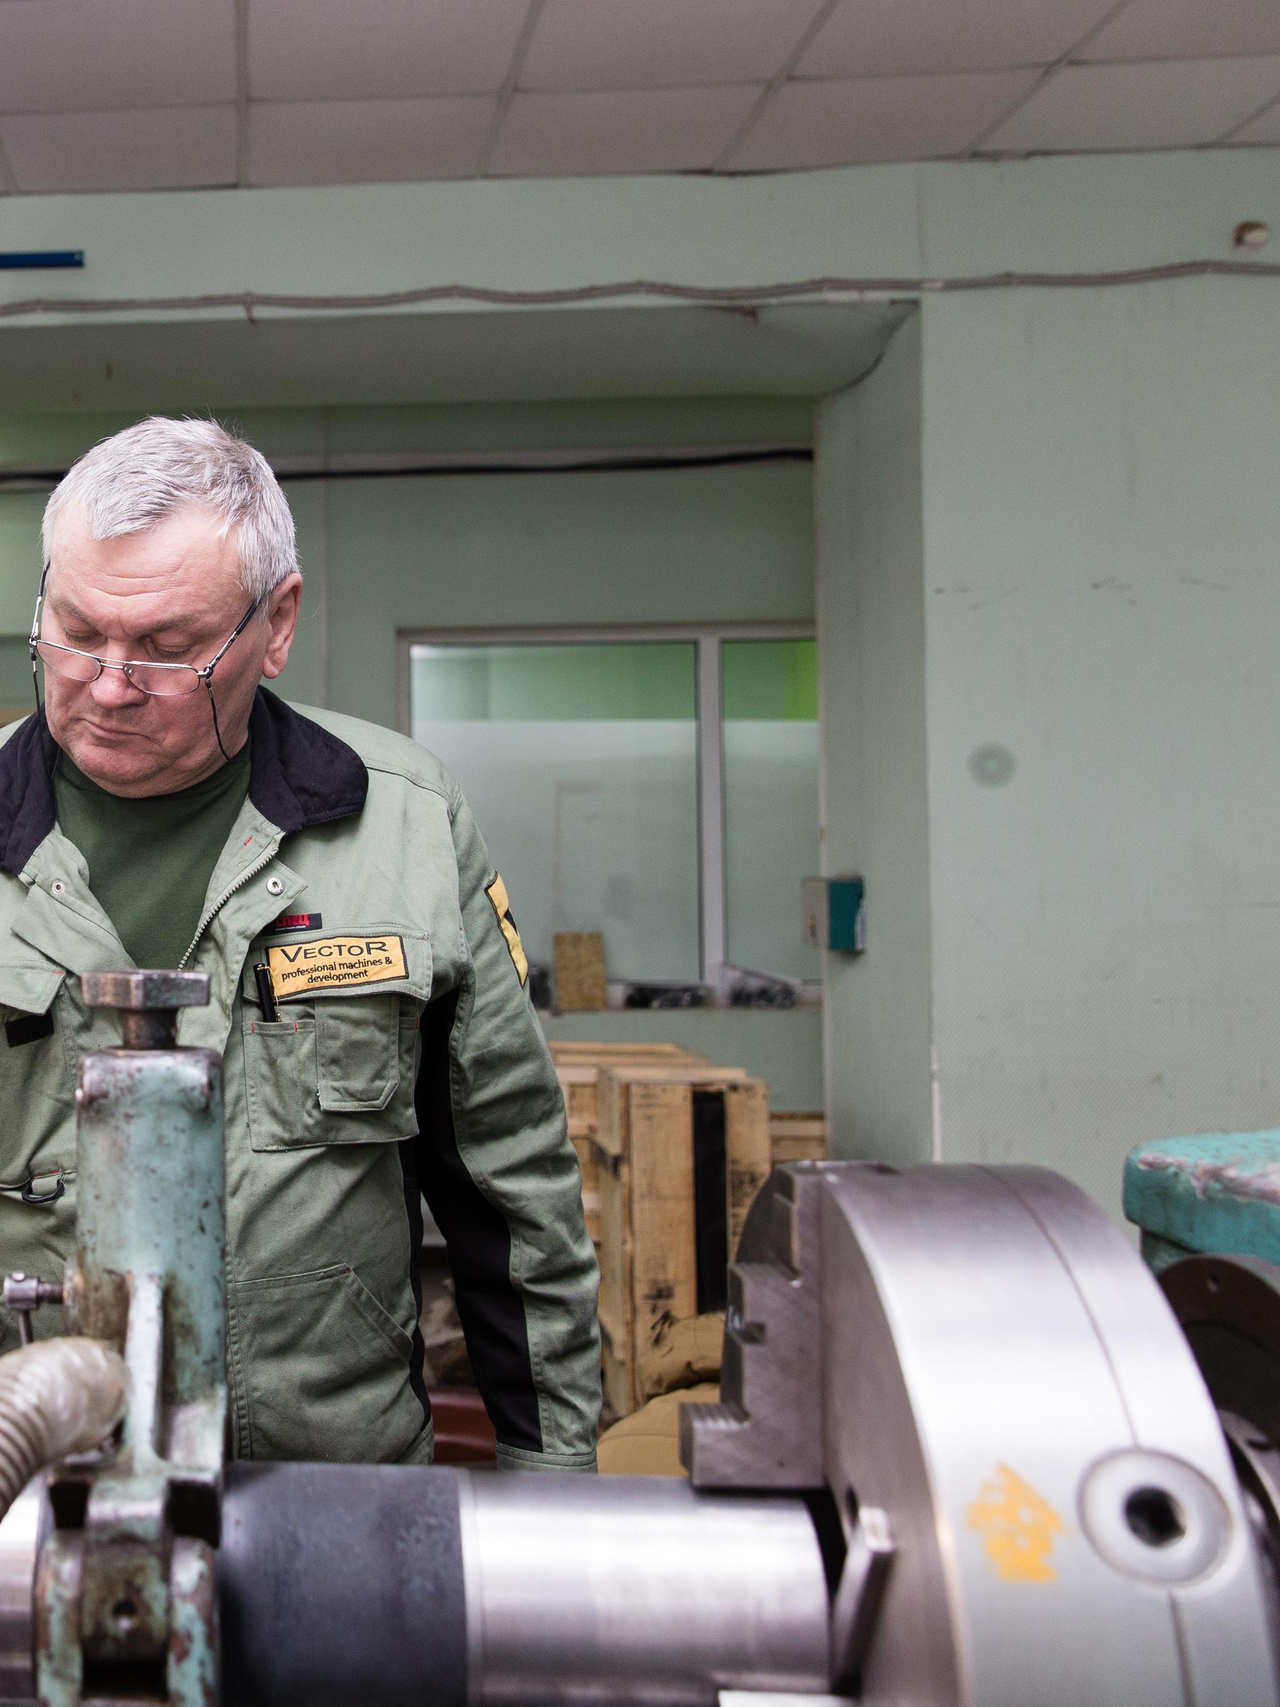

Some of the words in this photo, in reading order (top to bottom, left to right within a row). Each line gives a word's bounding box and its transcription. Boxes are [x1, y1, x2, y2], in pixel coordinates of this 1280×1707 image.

[281, 961, 337, 982] professional
[338, 957, 383, 971] machines
[384, 956, 393, 965] &
[307, 969, 369, 984] development
